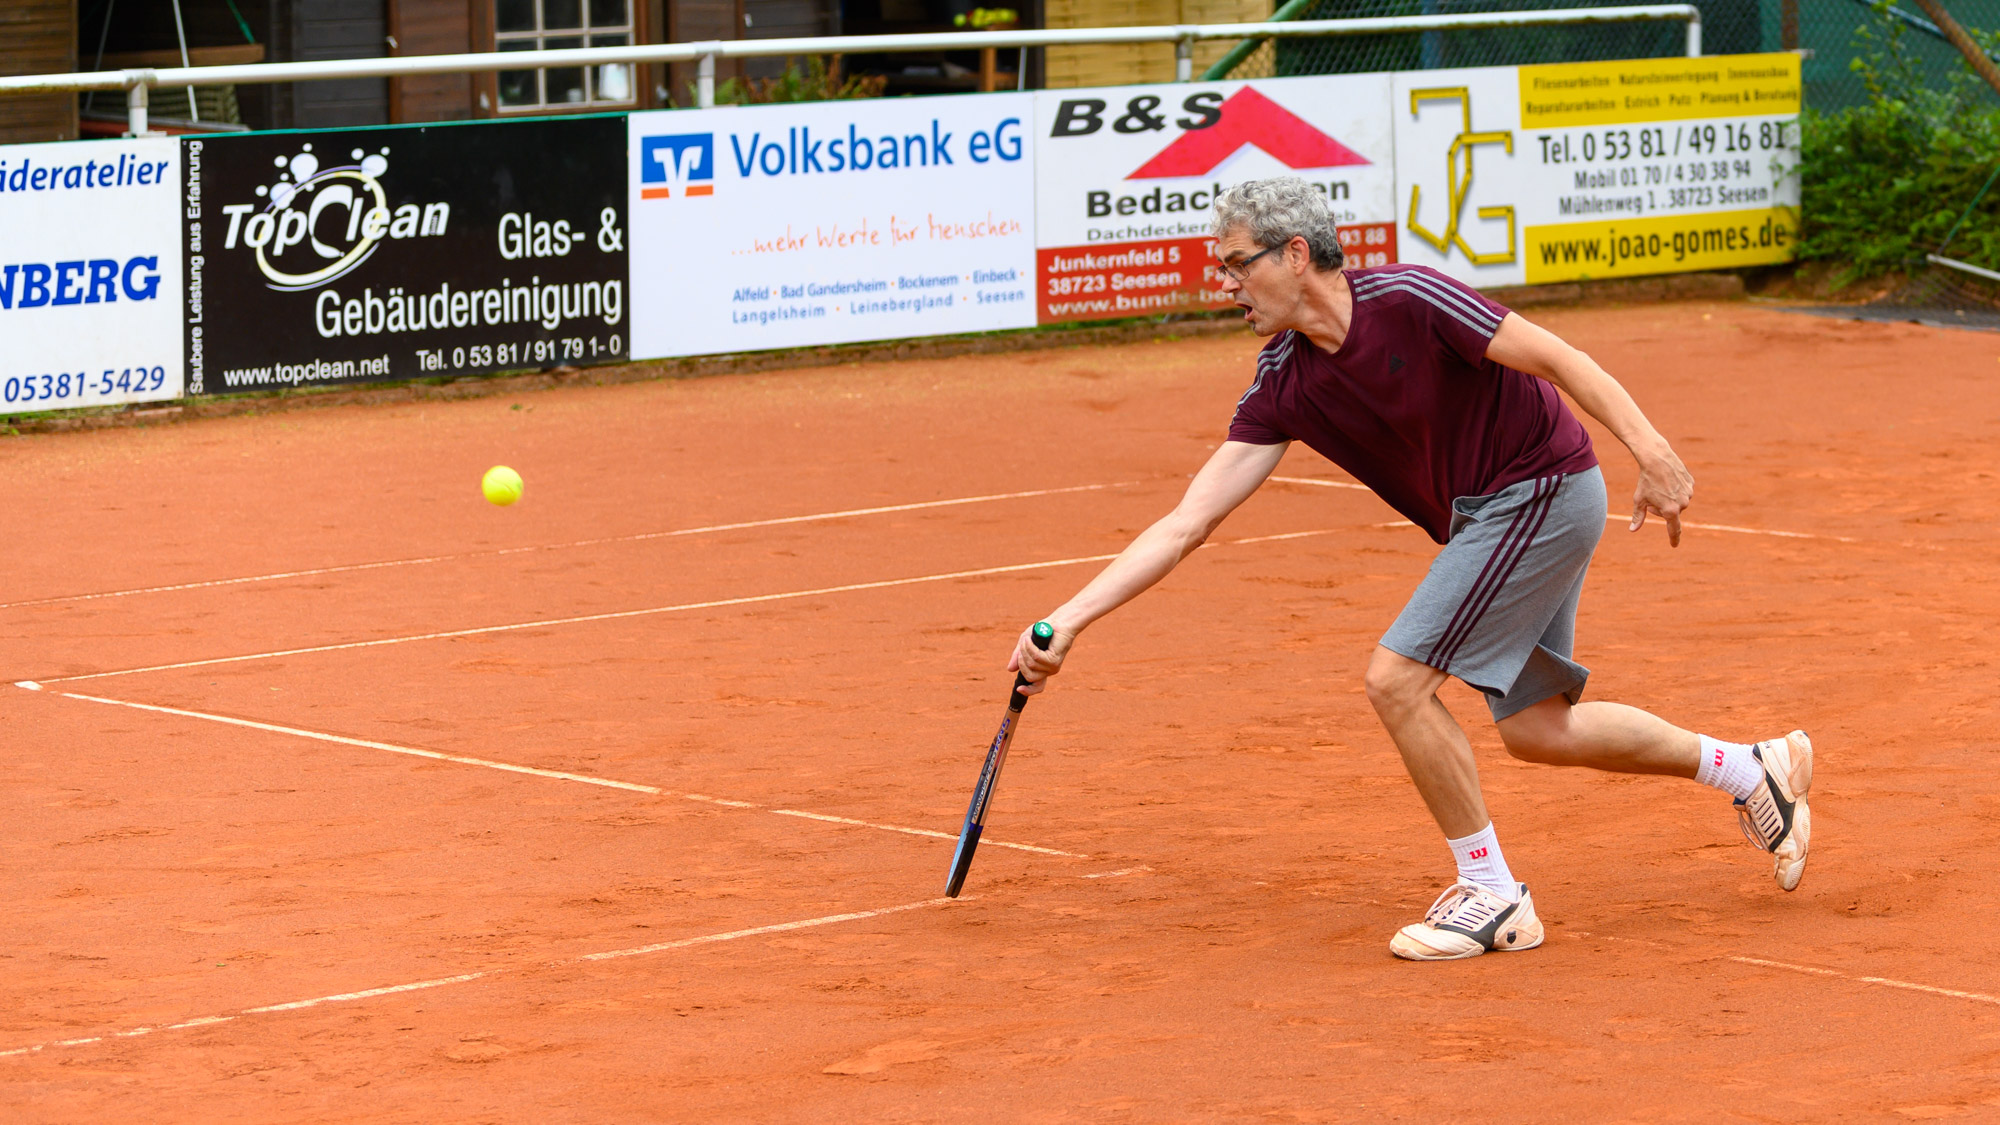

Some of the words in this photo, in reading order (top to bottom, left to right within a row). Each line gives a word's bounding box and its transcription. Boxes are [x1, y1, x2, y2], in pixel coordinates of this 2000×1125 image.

[730, 119, 953, 177] Volksbank
[968, 117, 1022, 163] eG
[1538, 133, 1577, 164] Tel.
[1583, 132, 1596, 162] 0
[1605, 130, 1631, 160] 53
[1640, 128, 1666, 158] 81
[1674, 126, 1682, 156] /
[1689, 124, 1716, 154] 49
[1725, 122, 1751, 152] 16
[1759, 121, 1785, 149] 81
[187, 141, 203, 218] Erfahrung
[1575, 168, 1616, 189] Mobil
[1620, 166, 1638, 187] 01
[1643, 165, 1662, 185] 70
[1675, 163, 1684, 181] 4
[1688, 161, 1707, 182] 30
[1711, 160, 1729, 180] 38
[1732, 159, 1751, 178] 94
[1559, 193, 1642, 215] Mühlenweg
[1648, 190, 1656, 209] 1
[1718, 184, 1768, 205] Seesen
[189, 223, 202, 252] aus
[222, 183, 450, 259] TopClean
[498, 212, 586, 260] Glas-
[597, 206, 623, 253] &
[816, 216, 881, 248] Werte
[890, 213, 920, 247] für
[927, 208, 1022, 241] Menschen
[1365, 226, 1387, 246] 88
[1048, 247, 1164, 273] Junkernfeld
[1168, 245, 1181, 264] 5
[1540, 217, 1787, 267] www.joao-gomes.de
[189, 256, 204, 323] Leistung
[732, 286, 770, 302] Alfeld
[780, 284, 804, 299] Bad
[807, 277, 887, 298] Gandersheim
[898, 274, 959, 290] Bockenem
[973, 266, 1017, 285] Einbeck
[1048, 273, 1107, 296] 38723
[1110, 271, 1181, 291] Seesen
[316, 275, 622, 338] Gebäudereinigung
[732, 304, 826, 325] Langelsheim
[850, 291, 954, 314] Leinebergland
[976, 289, 1025, 305] Seesen
[189, 327, 203, 394] Saubere
[223, 354, 391, 387] www.topclean.net
[416, 350, 448, 371] Tel.
[453, 347, 465, 369] 0
[470, 345, 493, 367] 53
[497, 343, 517, 364] 81
[535, 340, 556, 361] 91
[561, 337, 583, 360] 79
[4, 365, 165, 401] 05381-5429
